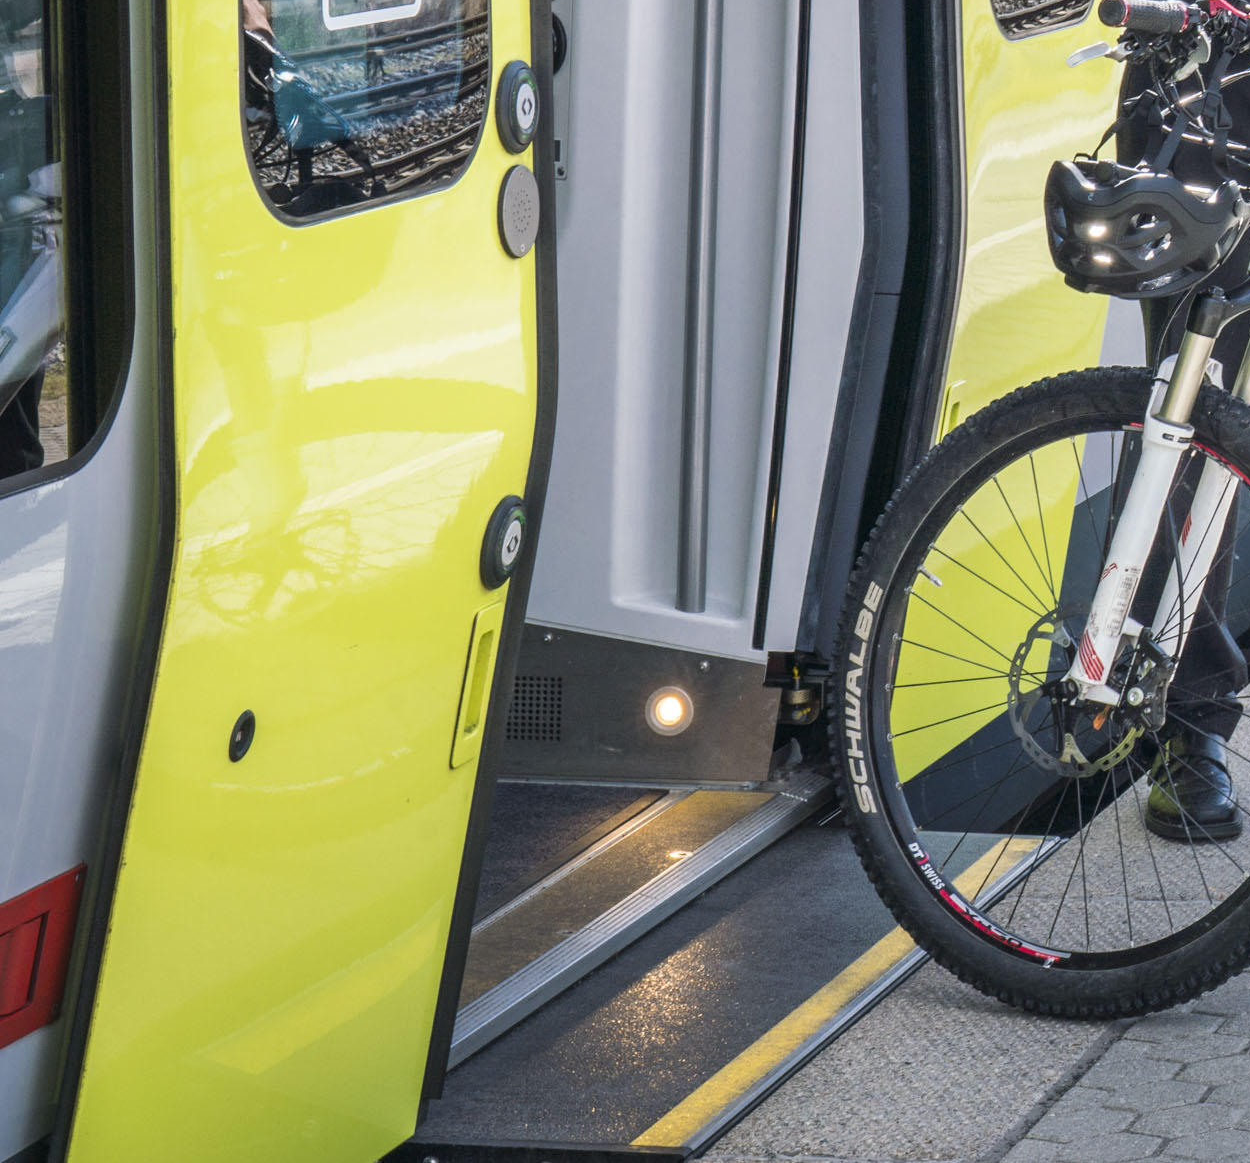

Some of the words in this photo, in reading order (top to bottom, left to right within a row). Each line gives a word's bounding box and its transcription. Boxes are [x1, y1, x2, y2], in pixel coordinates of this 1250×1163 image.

[845, 580, 884, 815] SCHWALBE
[907, 841, 925, 860] DT
[920, 862, 946, 890] SWISS
